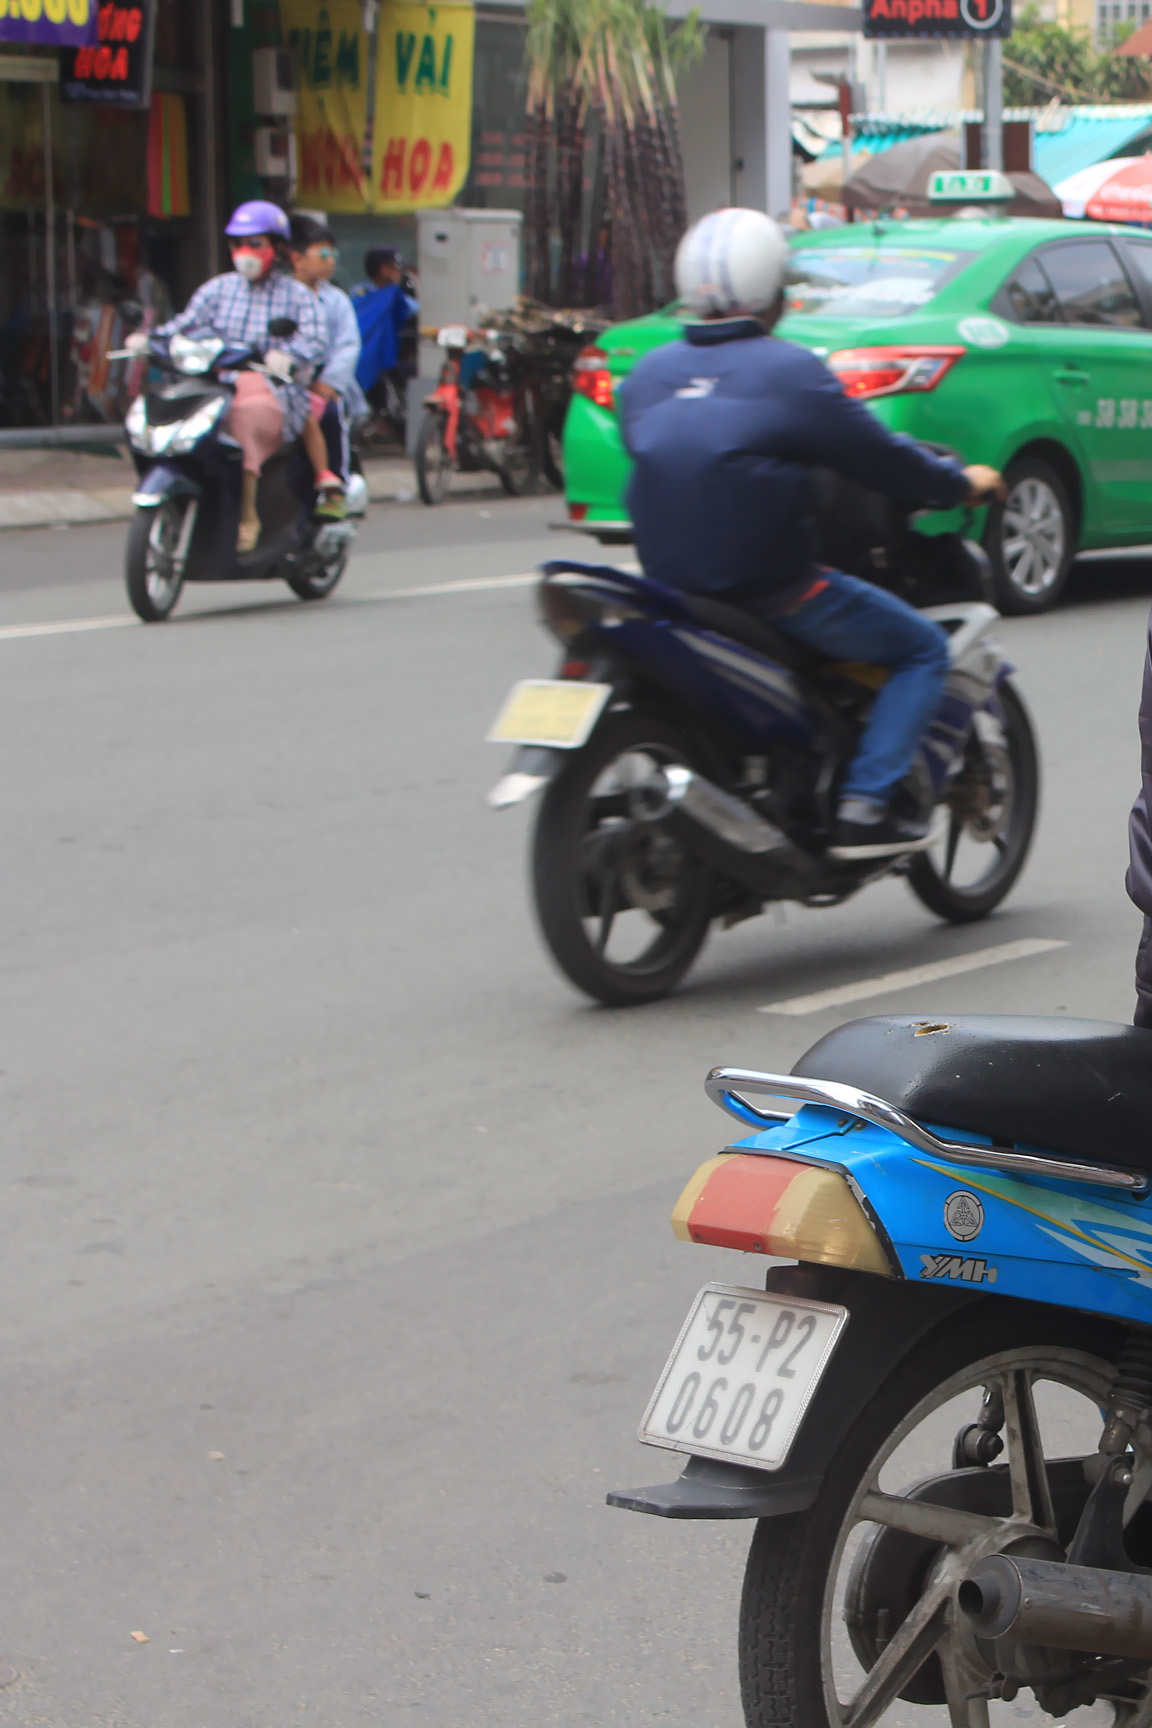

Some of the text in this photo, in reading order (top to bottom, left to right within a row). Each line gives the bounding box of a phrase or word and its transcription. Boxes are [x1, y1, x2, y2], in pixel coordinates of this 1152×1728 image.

[381, 136, 454, 198] HOA
[919, 1254, 998, 1284] YMH
[697, 1299, 818, 1379] 55-P2
[666, 1371, 785, 1451] 0608
